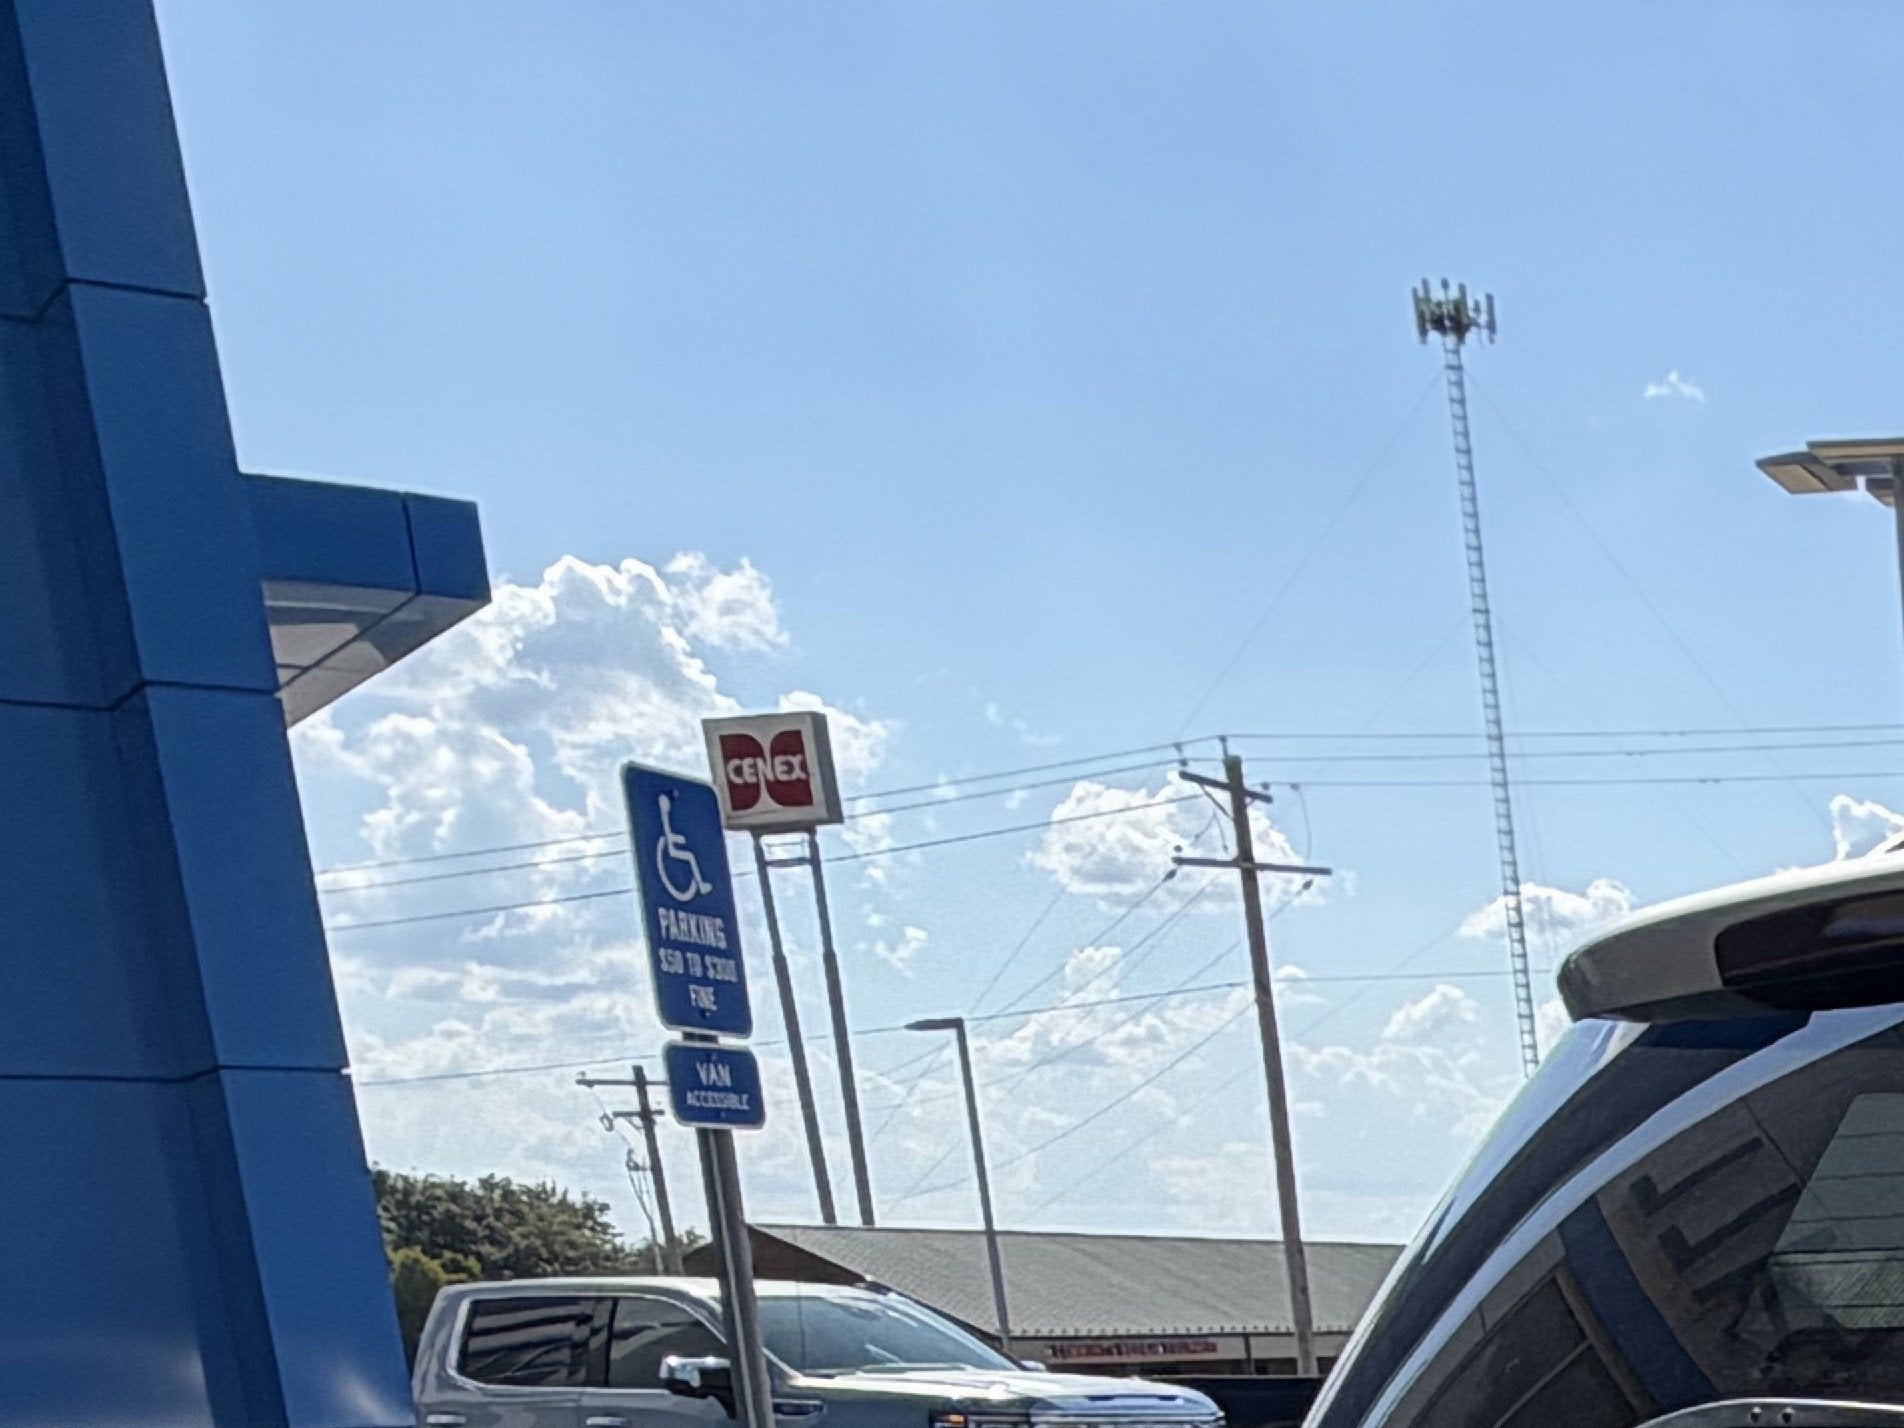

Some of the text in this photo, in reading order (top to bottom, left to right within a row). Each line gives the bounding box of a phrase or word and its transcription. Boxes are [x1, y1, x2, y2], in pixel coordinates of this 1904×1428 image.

[727, 754, 808, 785] CENEX
[658, 907, 728, 949] PARKING
[659, 948, 684, 974] $50
[686, 952, 704, 978] TO
[689, 985, 718, 1012] FINE
[695, 1061, 732, 1088] VAN
